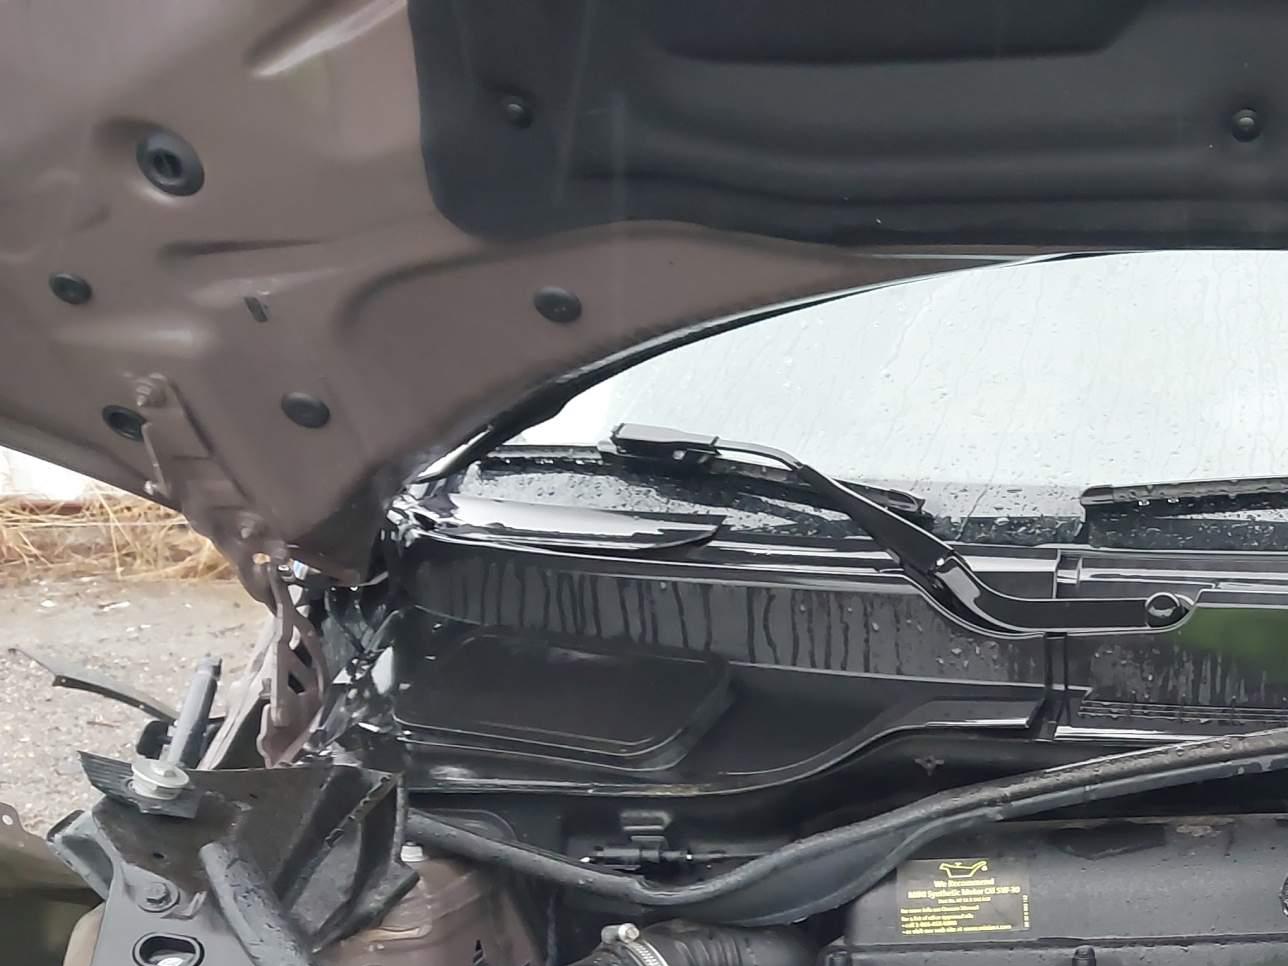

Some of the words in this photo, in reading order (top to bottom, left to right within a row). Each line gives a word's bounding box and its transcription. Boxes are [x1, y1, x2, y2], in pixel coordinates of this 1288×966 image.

[933, 880, 947, 888] We
[947, 877, 995, 888] Recommend
[927, 888, 960, 899] Synthetic
